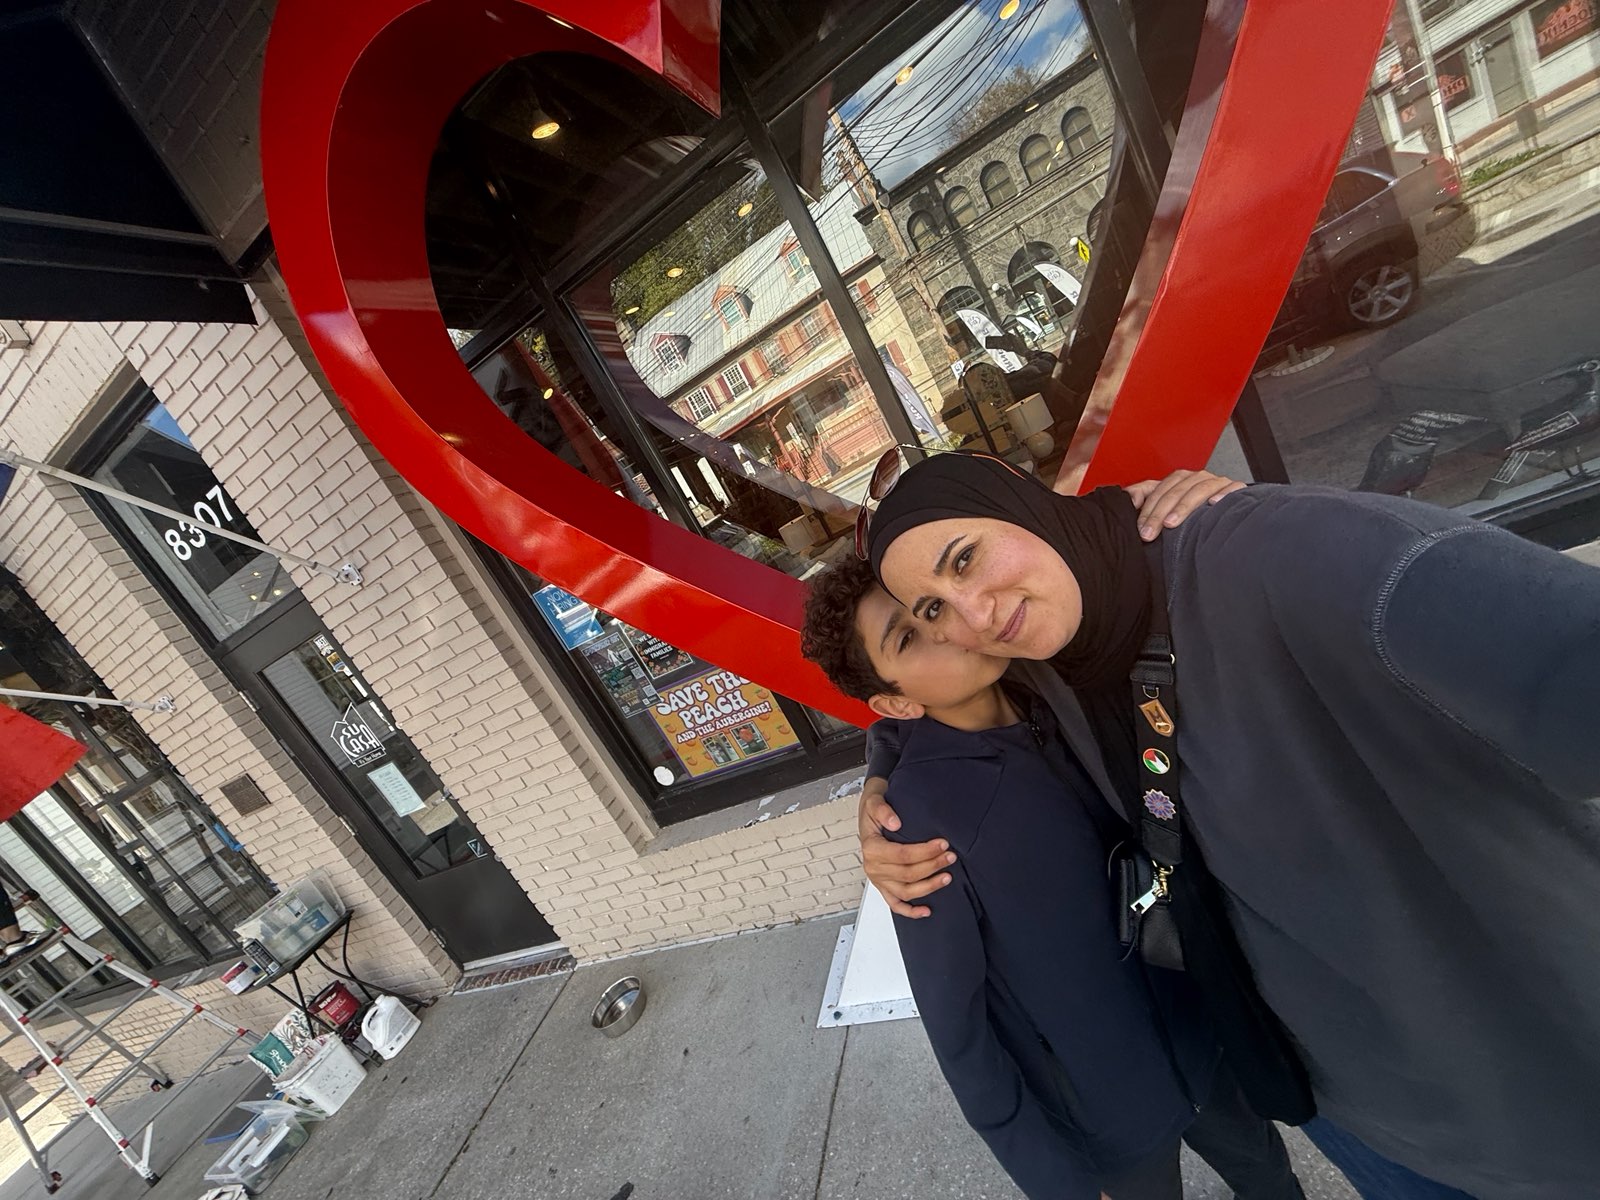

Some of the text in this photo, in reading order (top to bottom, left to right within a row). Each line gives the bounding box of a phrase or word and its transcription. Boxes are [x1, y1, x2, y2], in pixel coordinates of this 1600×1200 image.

[164, 486, 233, 561] 8307
[550, 596, 578, 615] HRING
[643, 641, 668, 655] IMMIGRA
[647, 637, 661, 646] WIT
[657, 682, 709, 715] SAVE
[678, 690, 749, 729] PEACH
[341, 723, 361, 739] SU
[677, 702, 772, 743] AND THE AUBERGINE!
[340, 724, 380, 758] CASA
